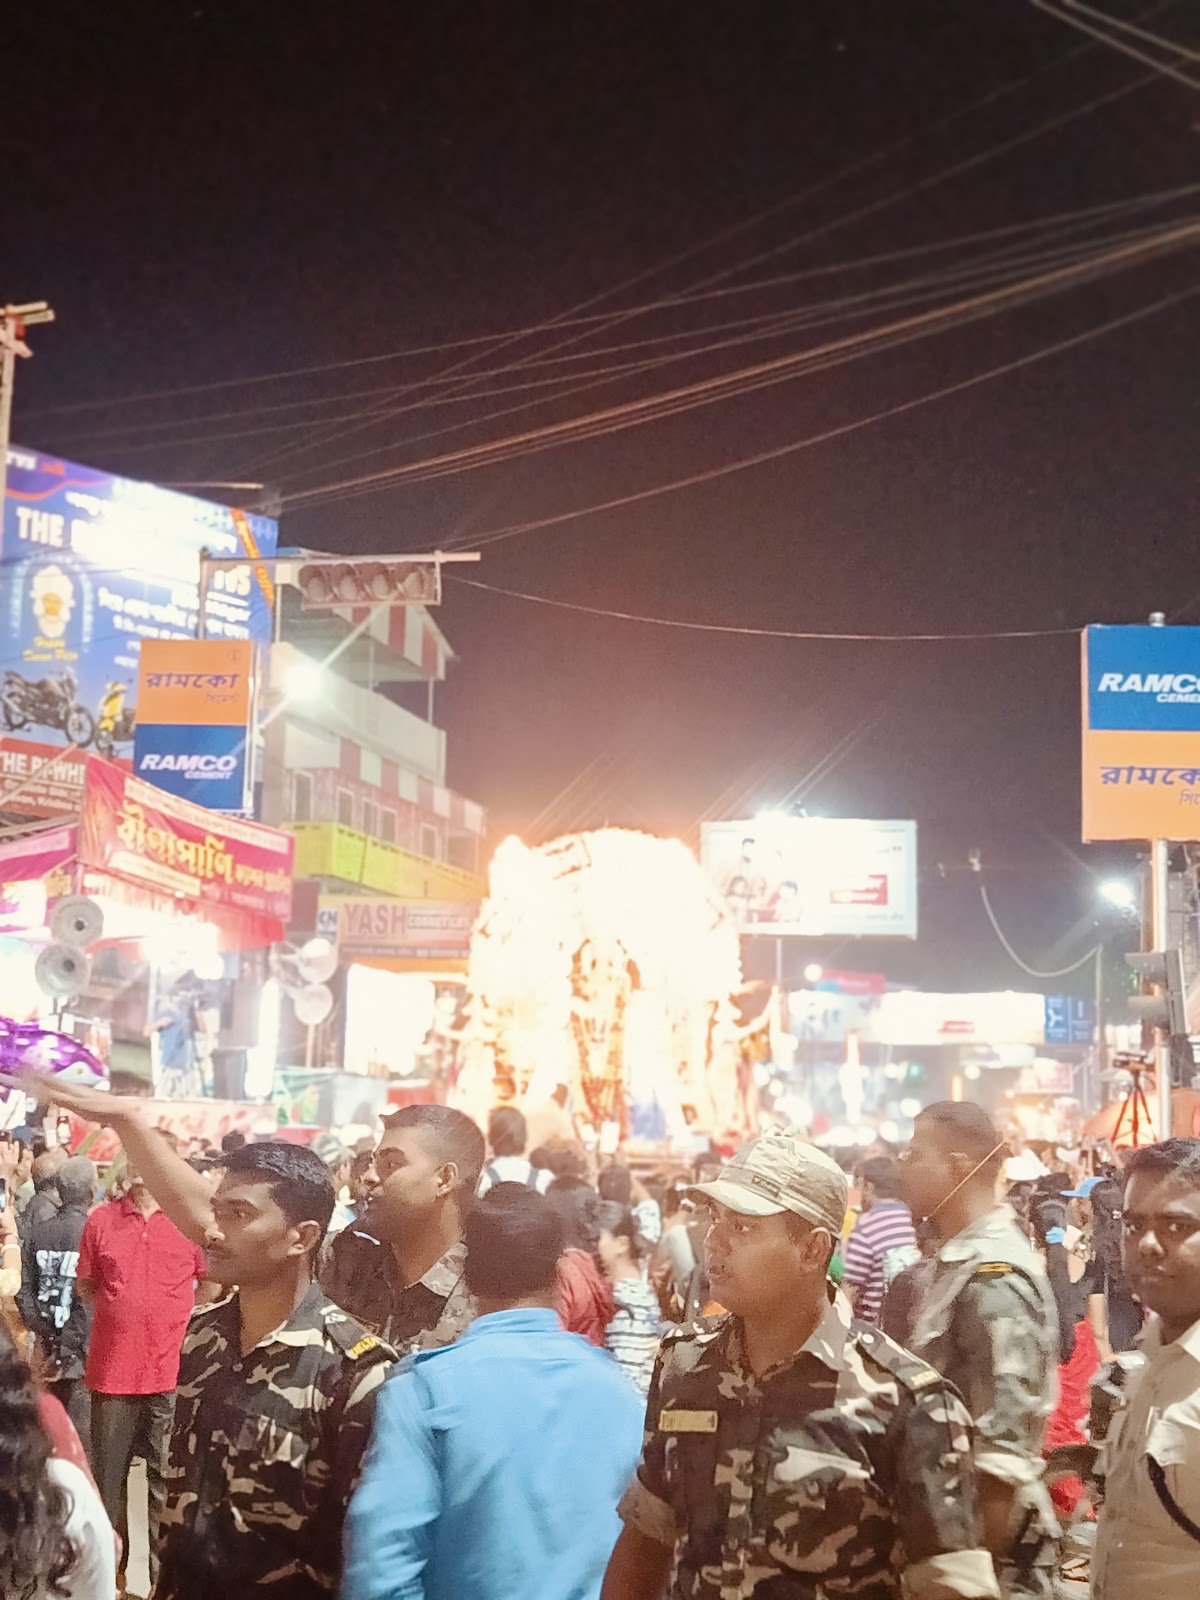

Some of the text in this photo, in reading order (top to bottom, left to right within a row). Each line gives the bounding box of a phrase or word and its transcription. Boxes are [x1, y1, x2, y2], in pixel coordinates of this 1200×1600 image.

[16, 507, 65, 549] THE
[146, 672, 241, 689] রামকো
[1097, 673, 1200, 693] RAMC
[139, 754, 238, 772] RAMCO
[183, 770, 234, 780] CEMENT
[343, 902, 407, 935] YASH
